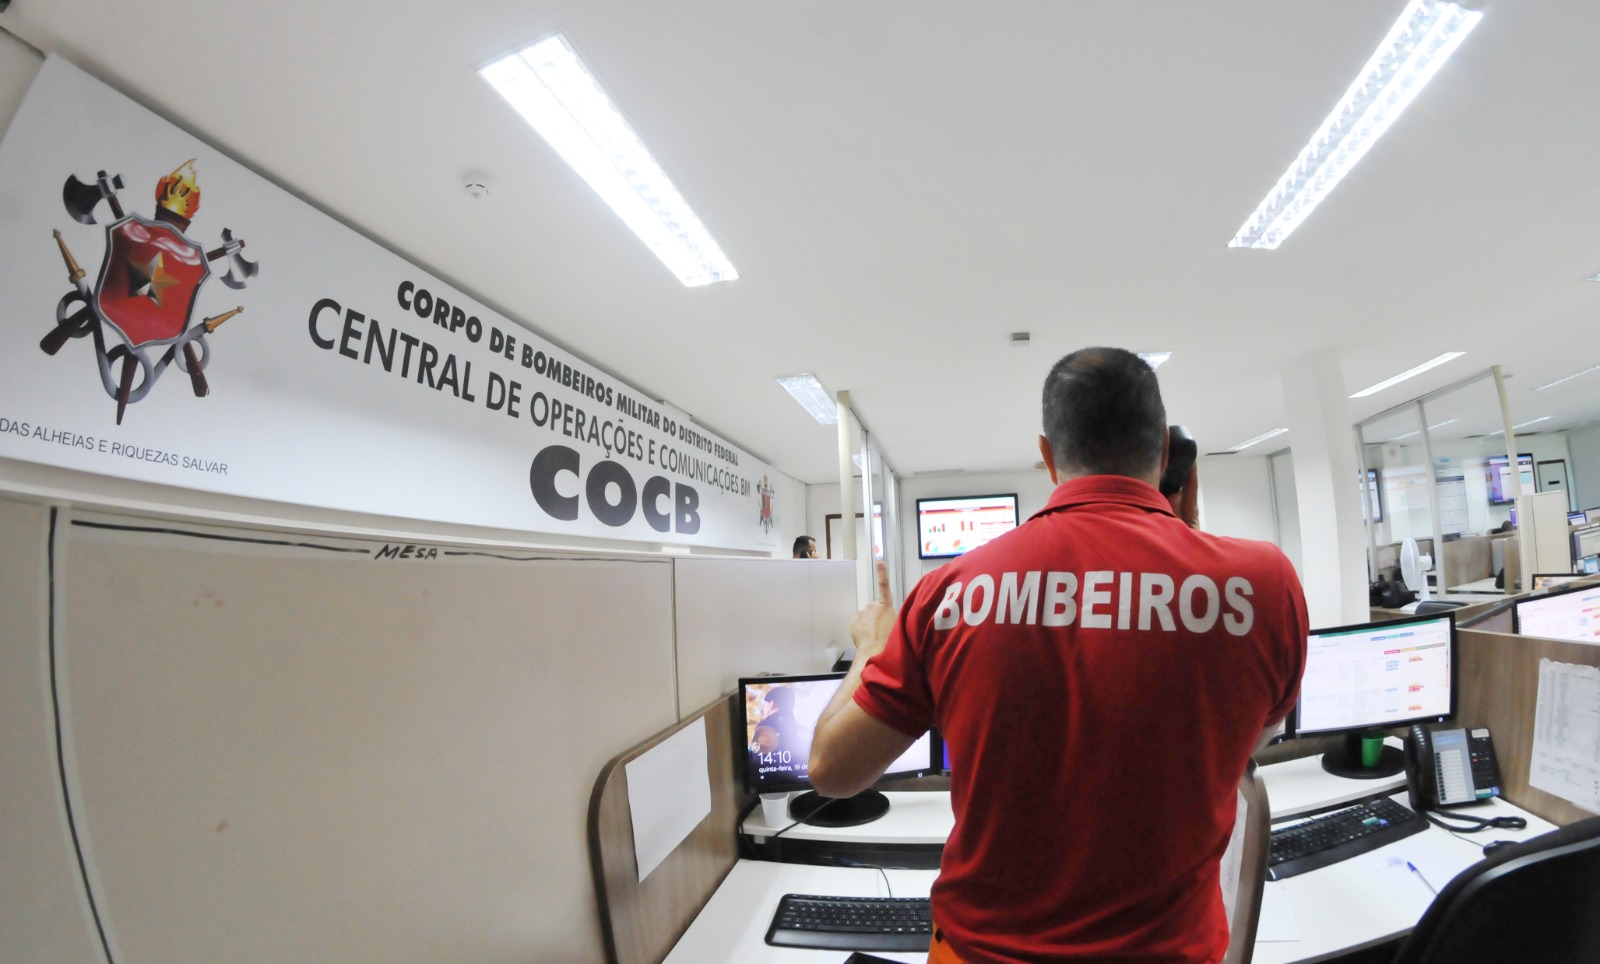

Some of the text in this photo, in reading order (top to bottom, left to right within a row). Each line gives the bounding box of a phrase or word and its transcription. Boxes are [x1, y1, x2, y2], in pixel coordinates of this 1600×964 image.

[308, 298, 751, 497] CENTRAL DE OPERAÇÕES E COMUNICAÇÕES BM
[397, 280, 738, 466] CORPO DE BOMBEIROS MILITAR DO DISTRITO FEDERAL
[33, 426, 94, 450] ALHEIAS
[99, 439, 107, 452] E
[111, 442, 179, 466] RIQUEZAS
[182, 456, 228, 475] SALVAR
[529, 445, 701, 535] COCB
[374, 544, 437, 560] MESA
[934, 570, 1254, 636] BOMBEIROS
[758, 750, 791, 765] 14:10
